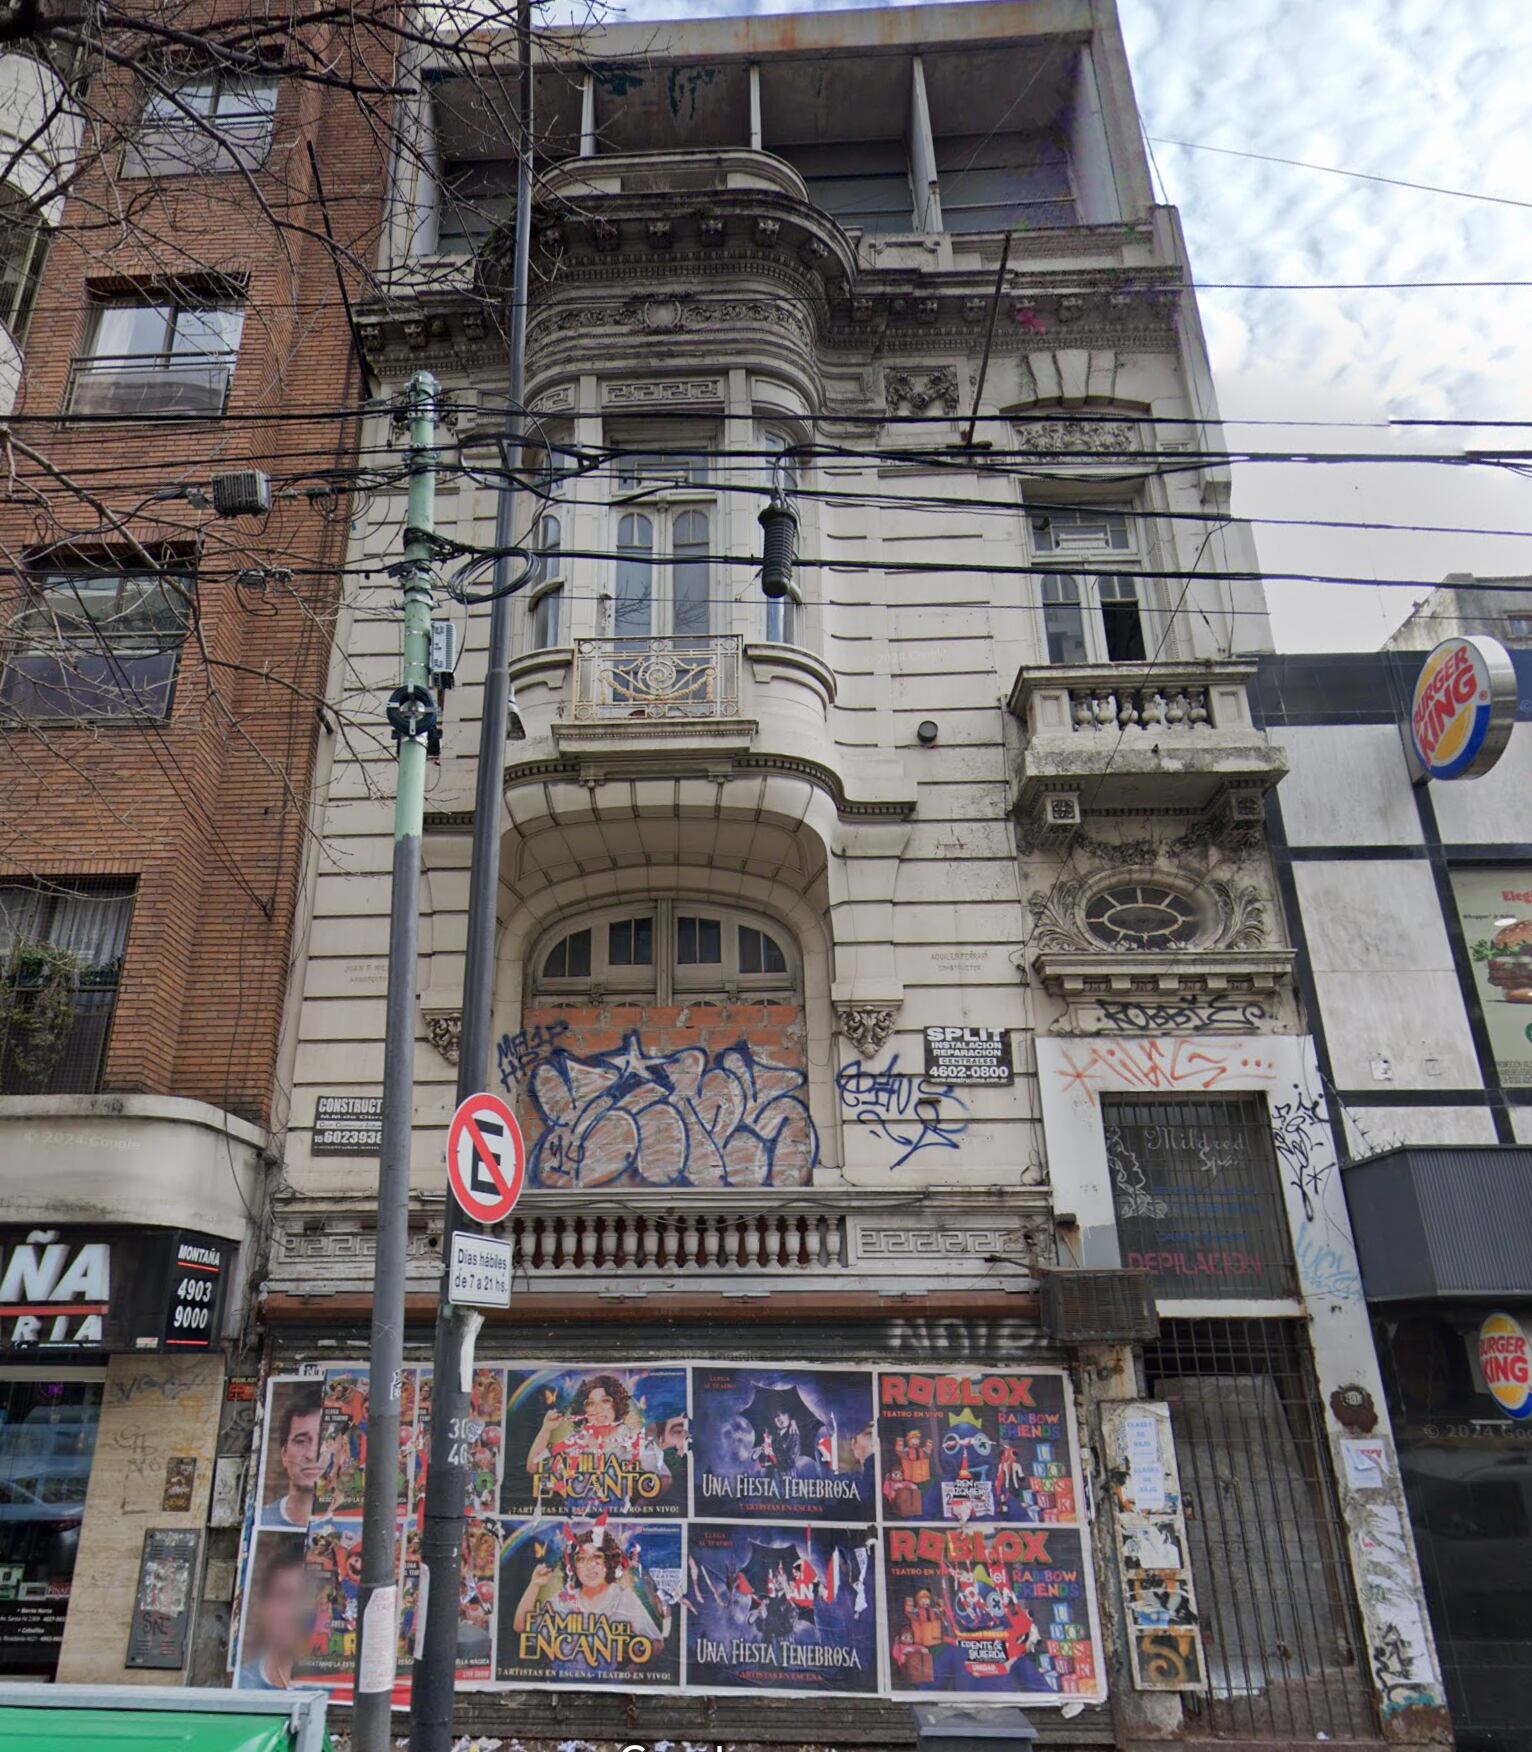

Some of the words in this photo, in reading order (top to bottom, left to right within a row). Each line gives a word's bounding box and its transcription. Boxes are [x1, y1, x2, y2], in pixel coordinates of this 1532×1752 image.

[1418, 664, 1478, 770] KING
[926, 1028, 1005, 1042] SPLIT
[928, 1066, 1009, 1078] 4602-0800
[1145, 1126, 1245, 1150] Mildred
[470, 1118, 504, 1196] E
[178, 1244, 220, 1266] MONTAÑA
[478, 1252, 508, 1272] hábiles
[176, 1278, 213, 1303] 4903
[454, 1274, 467, 1290] de
[469, 1274, 476, 1288] 7
[476, 1278, 482, 1290] a
[483, 1276, 494, 1292] 21
[172, 1305, 209, 1330] 9000
[881, 1375, 1037, 1407] ROBLOX
[883, 1410, 912, 1418] TEATRO
[998, 1412, 1060, 1425] RAINBOW
[999, 1424, 1061, 1439] FRIENDS
[532, 1472, 662, 1502] ENCANTO
[702, 1474, 734, 1498] UNA
[782, 1475, 862, 1502] TENEBROSA
[656, 1506, 680, 1514] VIVO!
[890, 1529, 1053, 1564] ROBLOX
[890, 1568, 922, 1576] TEATRO
[1012, 1570, 1078, 1582] RAINBOW
[1013, 1583, 1080, 1598] FRIENDS
[536, 1600, 554, 1616] LA
[526, 1612, 612, 1637] FAMILIA
[612, 1622, 632, 1634] DEL
[519, 1632, 653, 1668] ENCANTO
[696, 1638, 728, 1664] UNA
[780, 1642, 862, 1671] TENEBROSA
[504, 1668, 543, 1677] ARTISTAS
[546, 1669, 556, 1677] EN
[598, 1671, 630, 1679] TEATRO
[633, 1672, 644, 1680] EN
[646, 1672, 671, 1681] VIVO!
